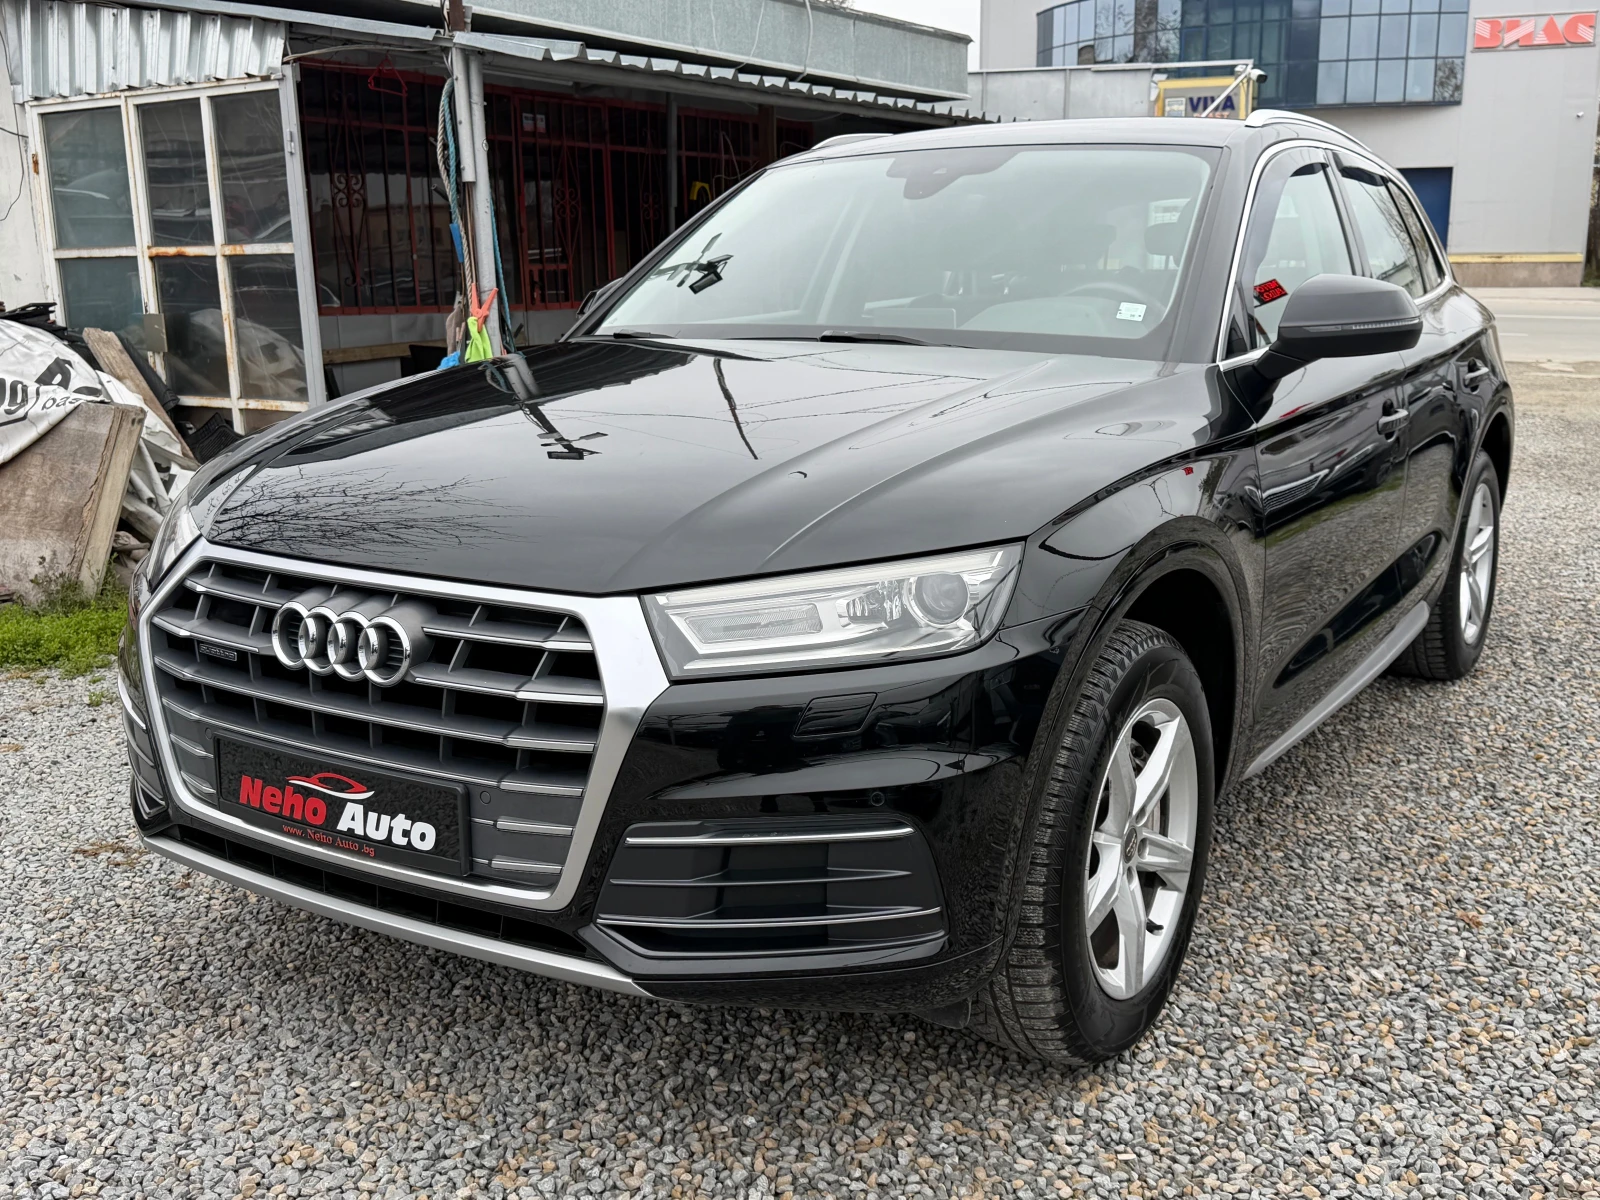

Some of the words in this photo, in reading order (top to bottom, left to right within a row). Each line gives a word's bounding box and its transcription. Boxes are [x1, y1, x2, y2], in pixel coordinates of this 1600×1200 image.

[239, 775, 327, 825] Neho
[282, 824, 305, 837] www.
[307, 829, 333, 844] Neho
[335, 836, 359, 851] Auto
[361, 844, 375, 857] .bg
[336, 802, 437, 850] Auto
